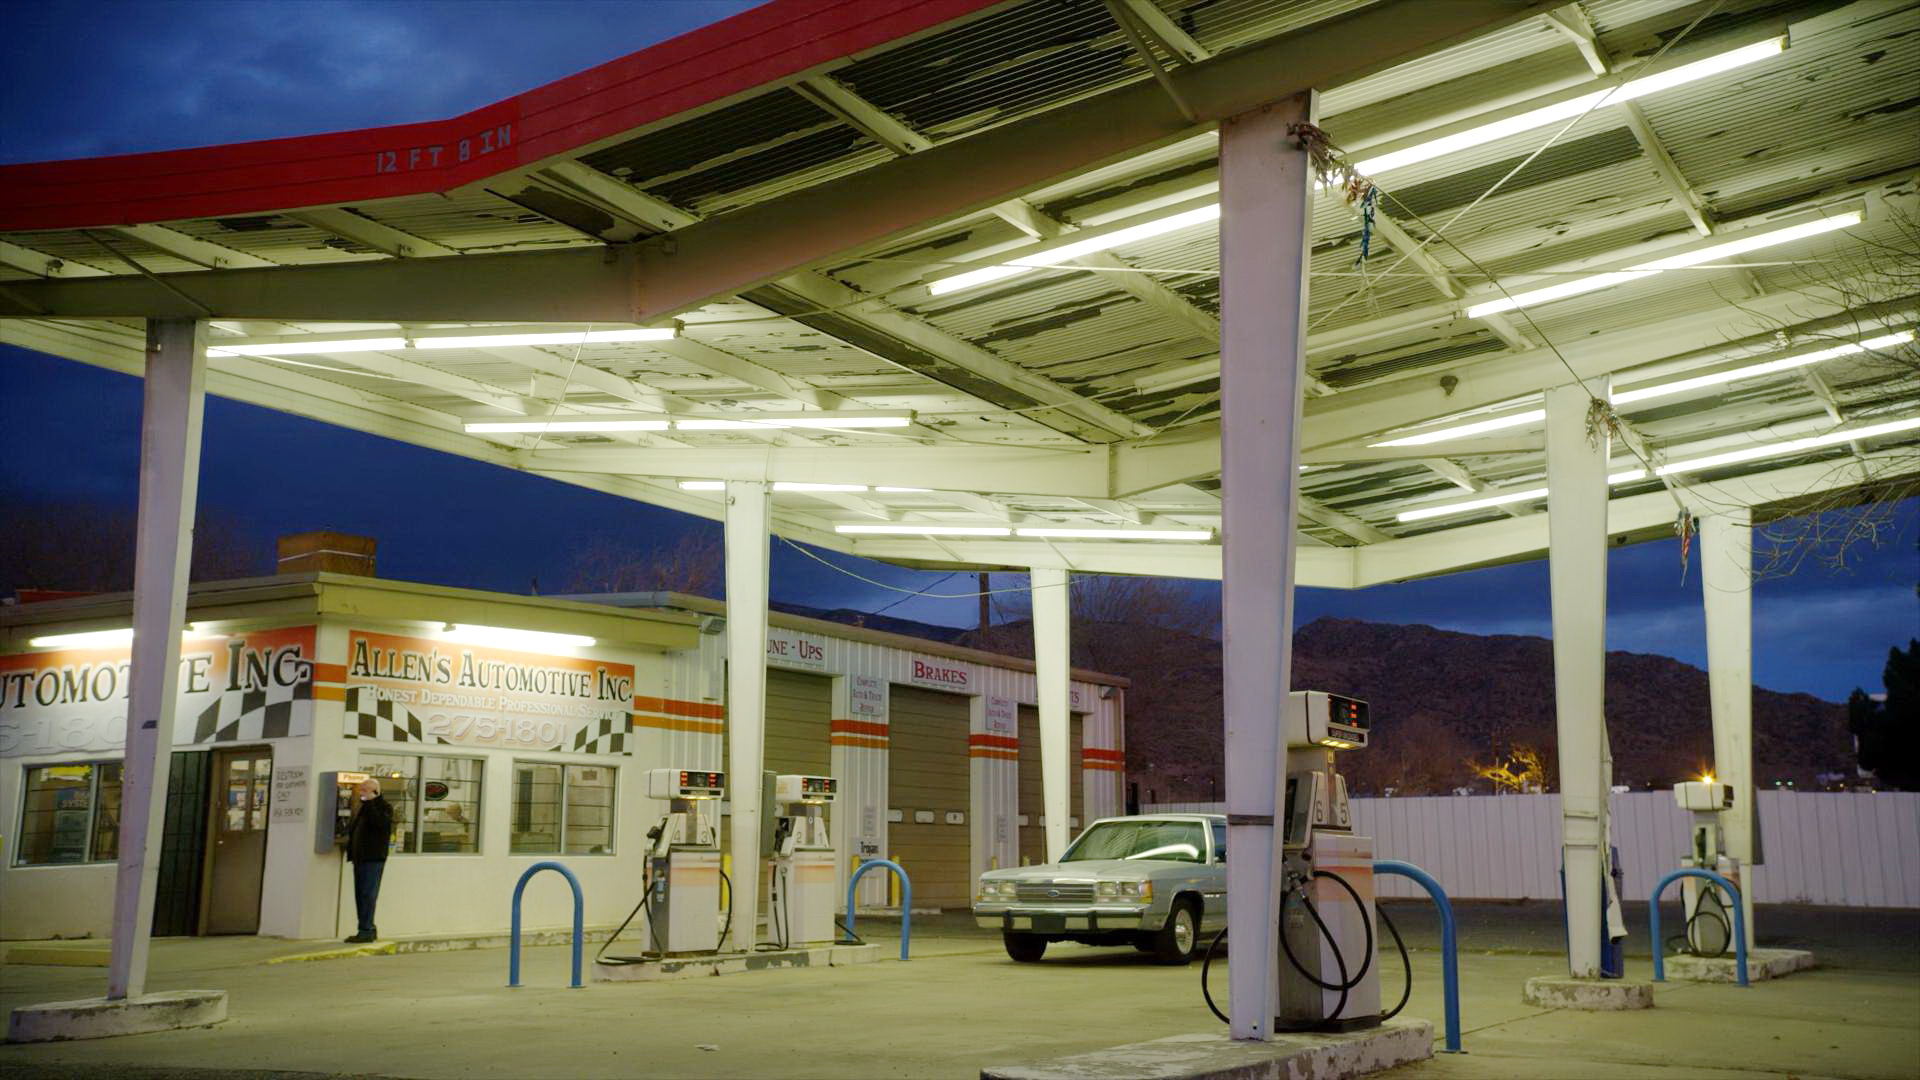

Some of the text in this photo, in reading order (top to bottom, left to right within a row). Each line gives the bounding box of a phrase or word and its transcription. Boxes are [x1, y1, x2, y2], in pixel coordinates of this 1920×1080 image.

[376, 151, 398, 173] 12
[409, 146, 444, 170] FT
[479, 124, 512, 154] IN
[799, 639, 823, 661] UPS
[351, 640, 633, 702] ALLEN'S AUTOMOTIVE INC.
[914, 660, 967, 685] BRAKES
[427, 711, 568, 746] 275-1801
[1316, 801, 1323, 823] 6
[1340, 802, 1347, 824] 5
